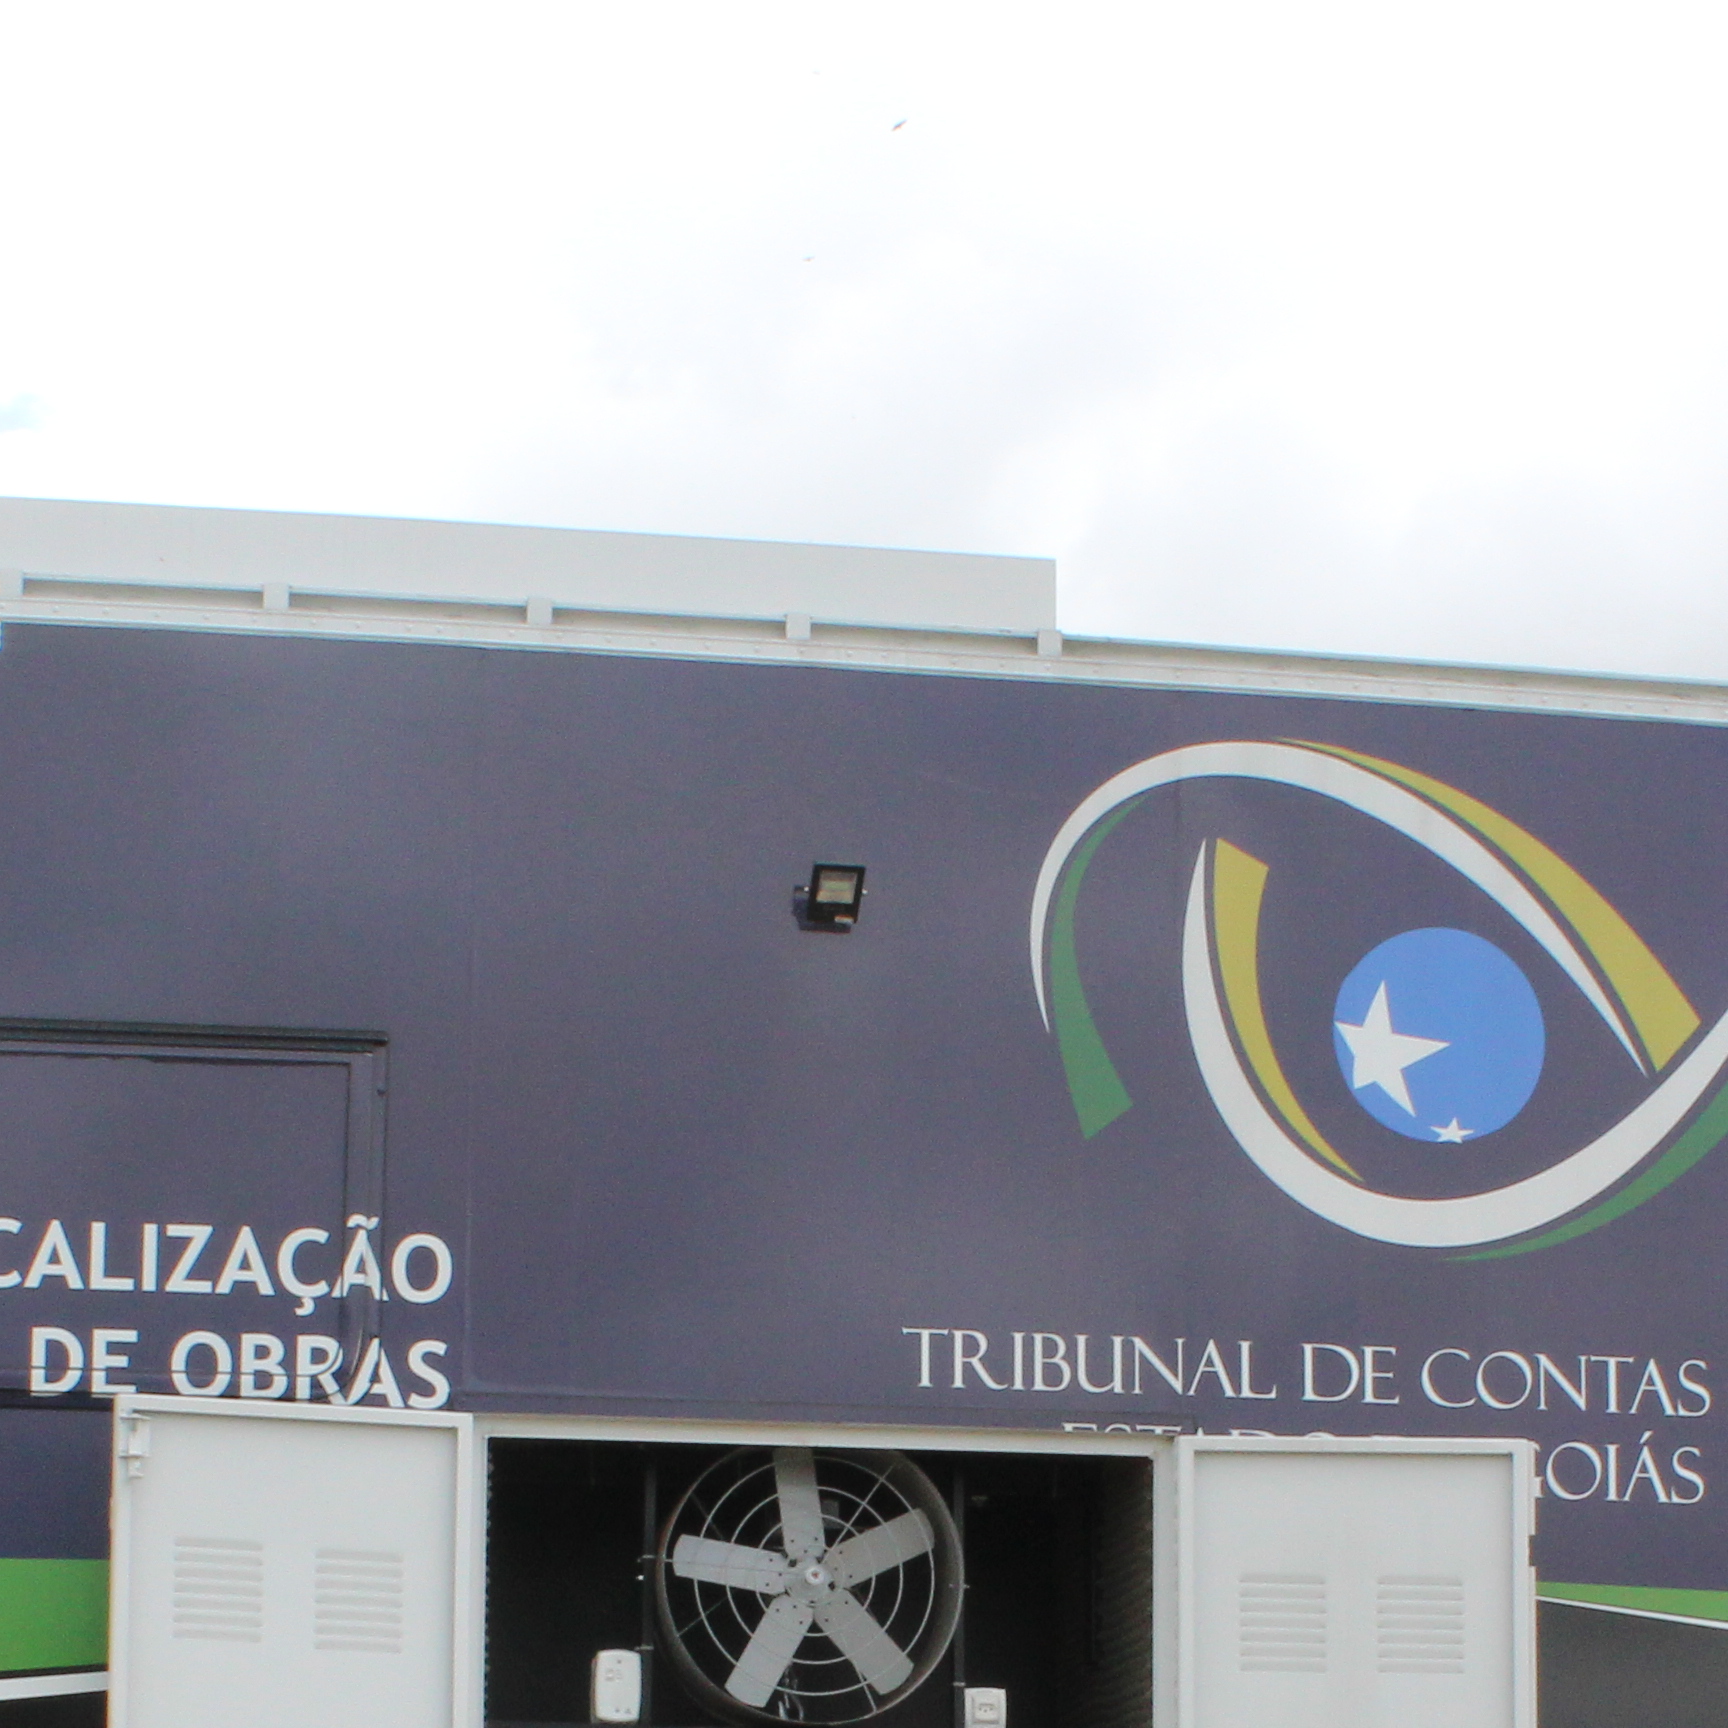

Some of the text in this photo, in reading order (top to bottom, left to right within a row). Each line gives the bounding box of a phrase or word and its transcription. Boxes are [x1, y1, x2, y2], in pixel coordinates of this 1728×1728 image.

[29, 1326, 451, 1410] DE OBRAS
[900, 1327, 1277, 1400] TRIBUNAL
[1301, 1343, 1401, 1405] DE
[1420, 1348, 1711, 1418] CONTAS
[1535, 1430, 1706, 1505] OIÁS
